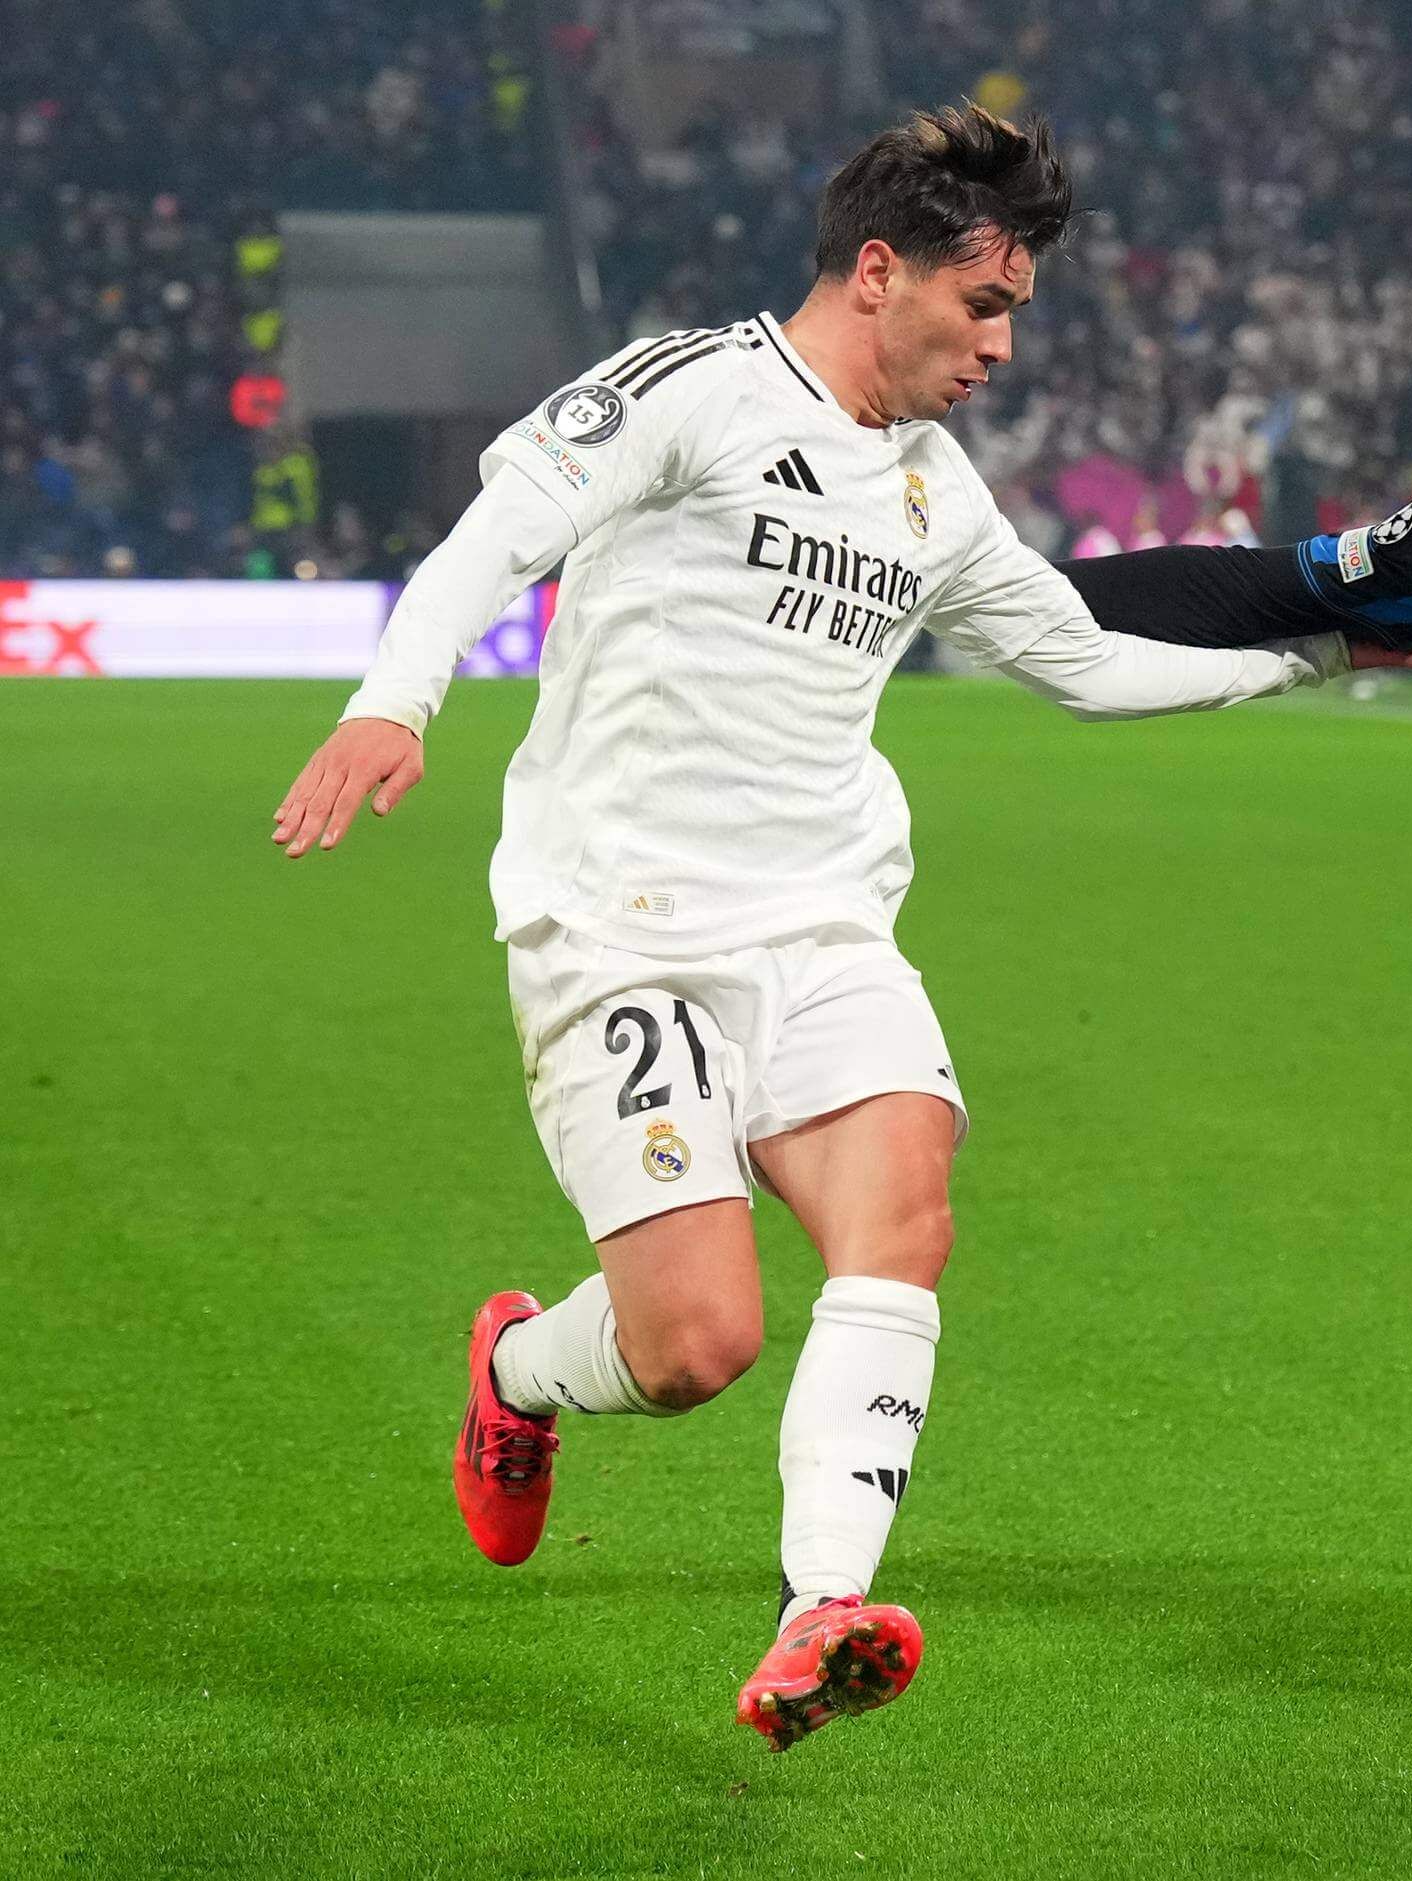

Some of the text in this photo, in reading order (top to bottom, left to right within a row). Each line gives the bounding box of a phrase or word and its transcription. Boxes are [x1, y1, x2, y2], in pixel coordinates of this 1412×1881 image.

[568, 404, 594, 424] 15
[747, 513, 922, 614] Emirates
[766, 585, 825, 634] FLY
[604, 999, 711, 1120] 21
